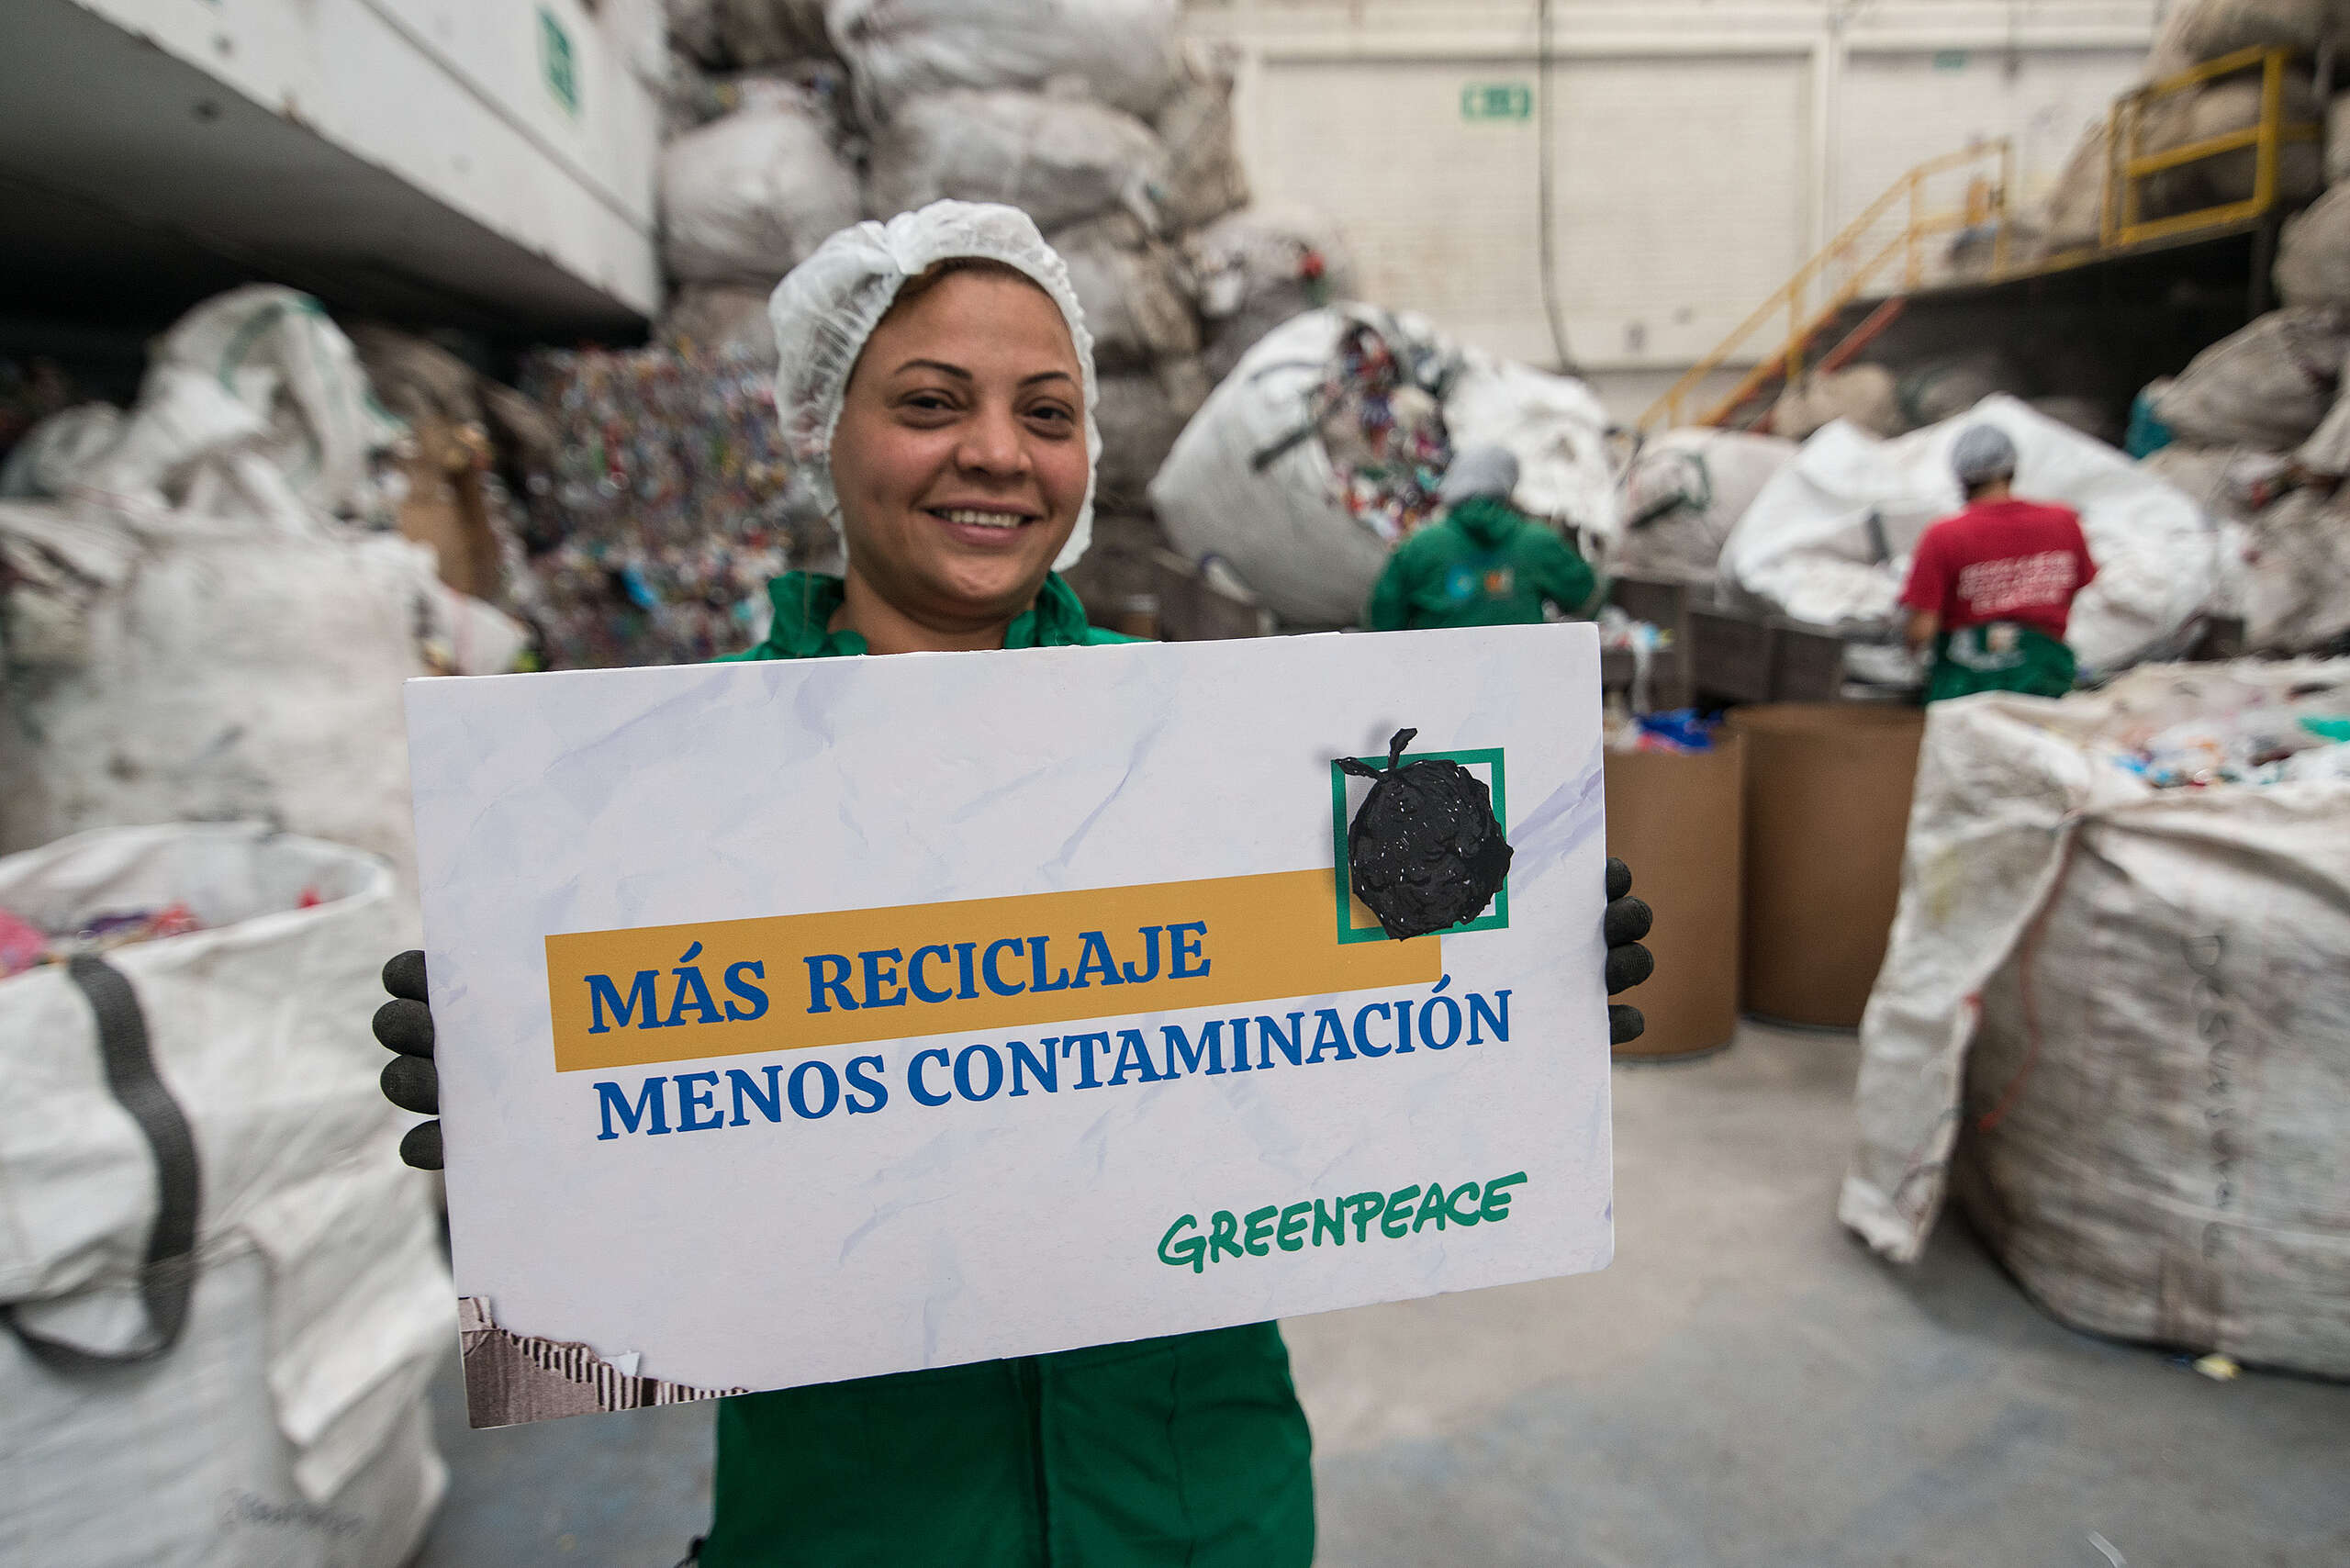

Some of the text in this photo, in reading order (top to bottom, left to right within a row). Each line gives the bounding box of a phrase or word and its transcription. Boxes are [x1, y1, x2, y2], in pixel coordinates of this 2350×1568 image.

[584, 921, 1211, 1034] MÁS RECICLAJE
[592, 973, 1513, 1141] MENOS CONTAMINACIÓN
[1157, 1170, 1528, 1274] GREENPEACE
